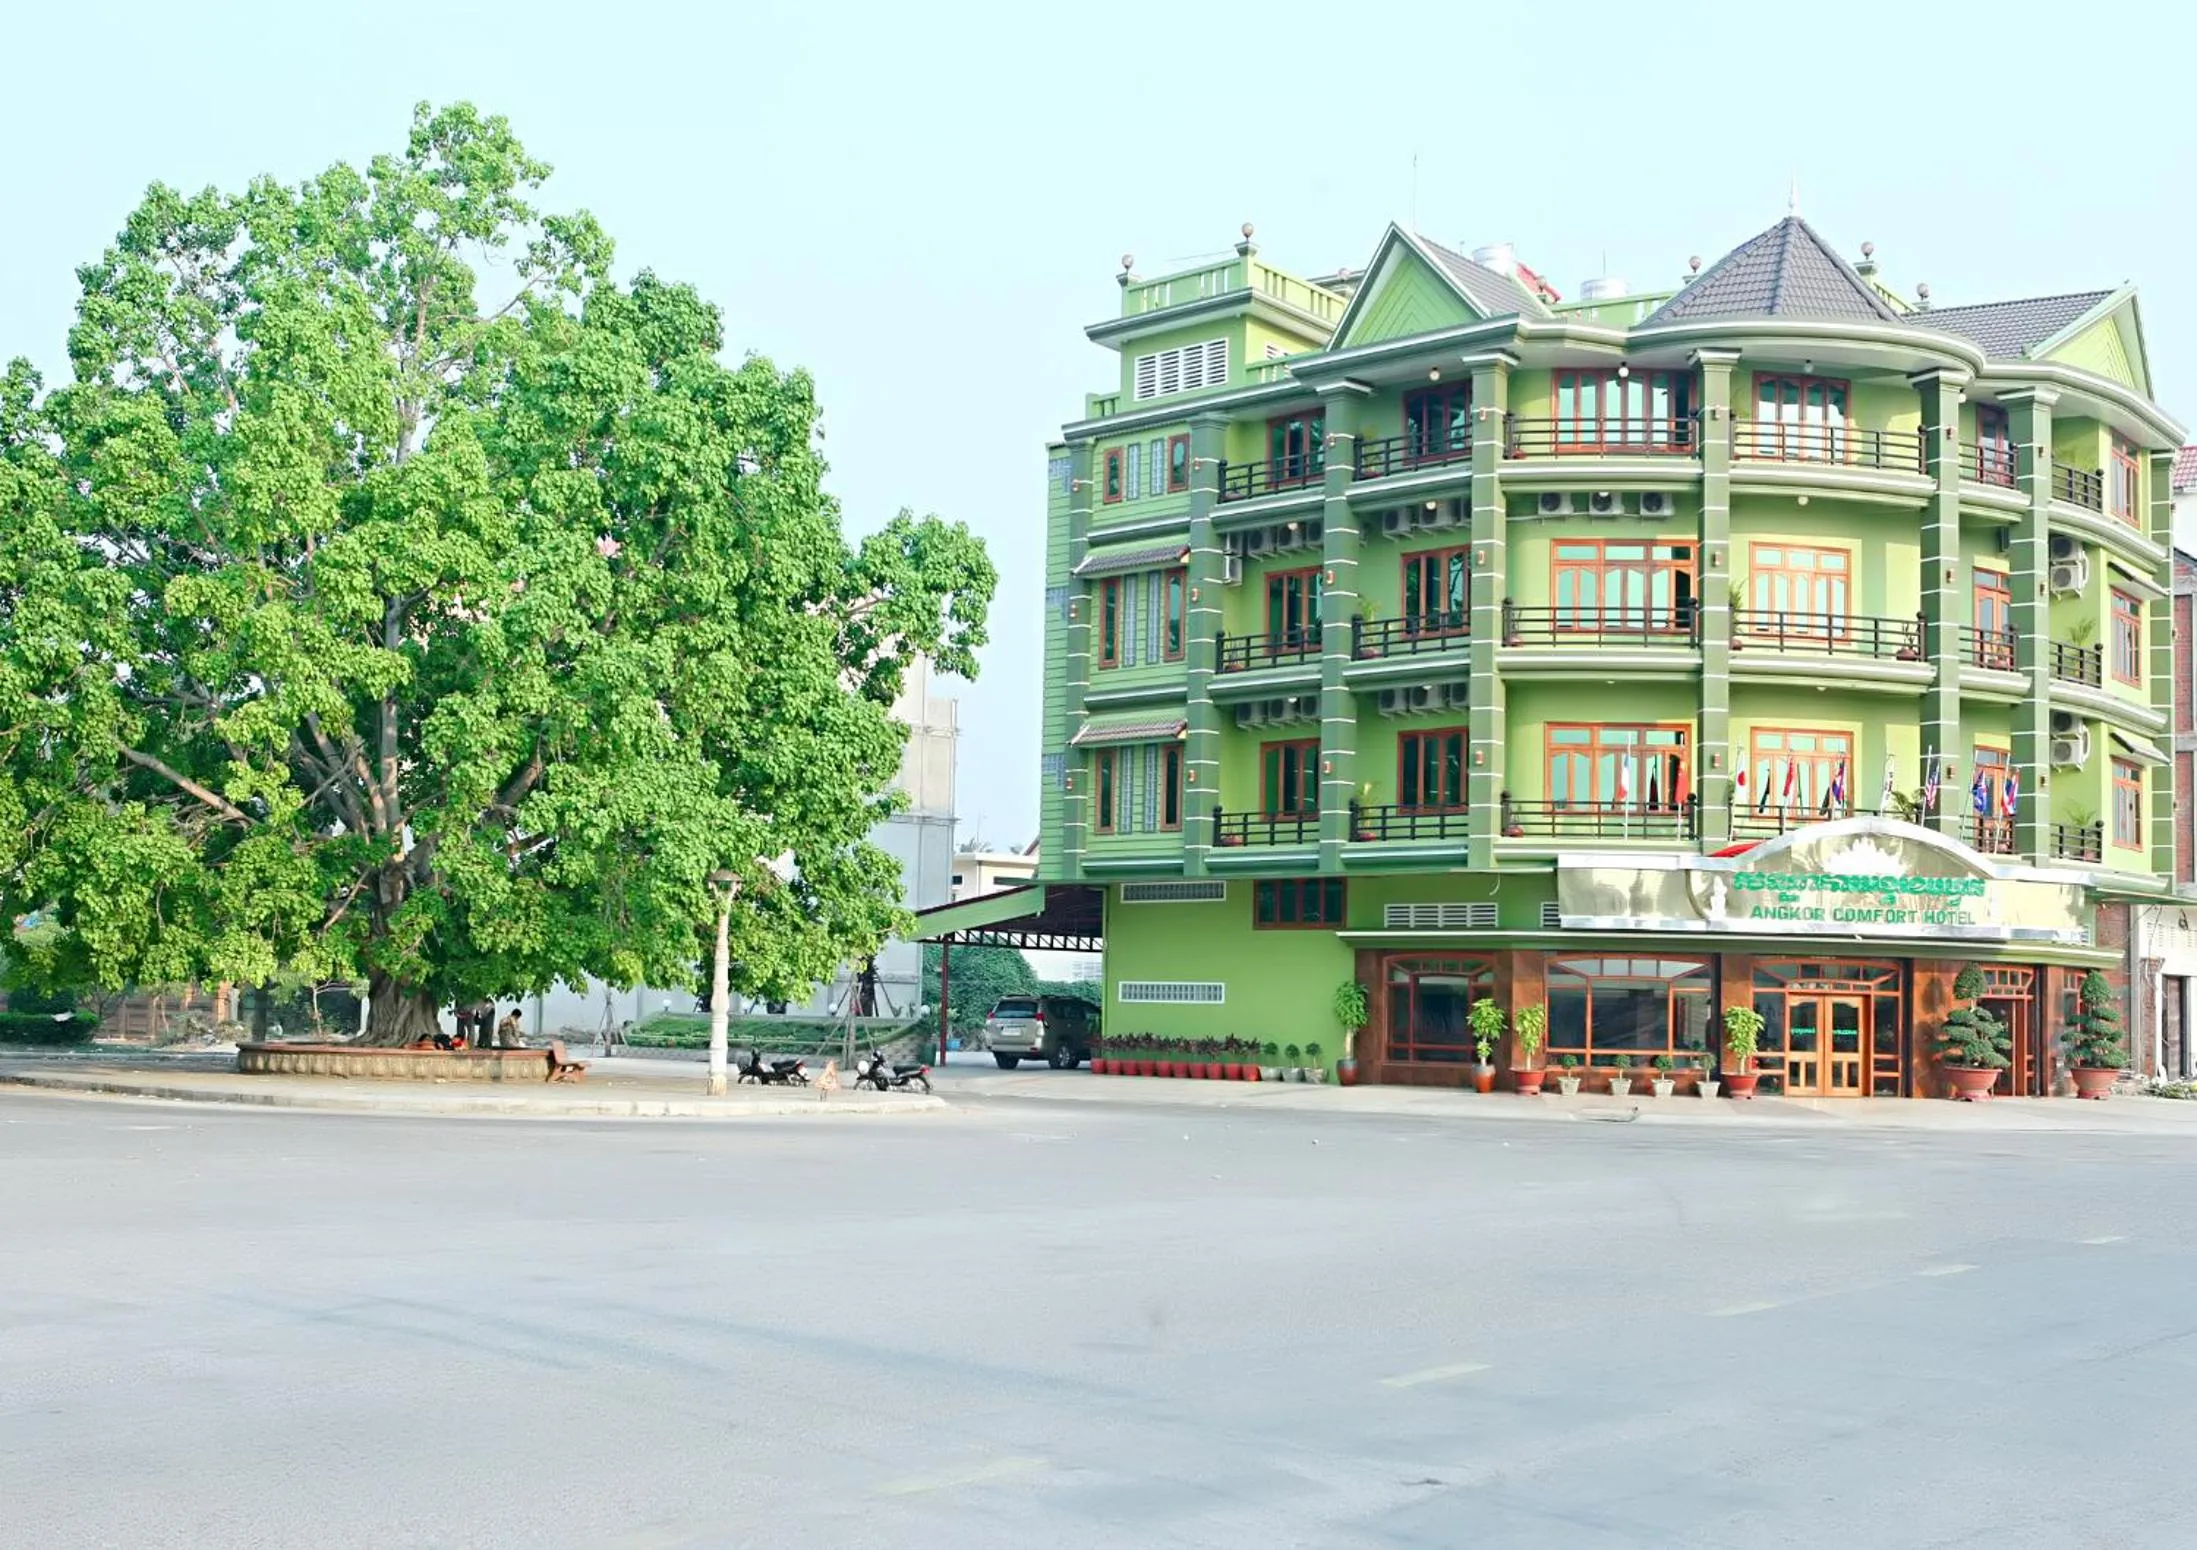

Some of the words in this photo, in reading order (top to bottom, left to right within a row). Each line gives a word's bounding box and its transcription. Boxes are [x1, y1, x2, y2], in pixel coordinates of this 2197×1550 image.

[1750, 905, 1825, 921] ANGKOR
[1833, 907, 1918, 924] COMFORT
[1923, 910, 1976, 925] HOTEL
